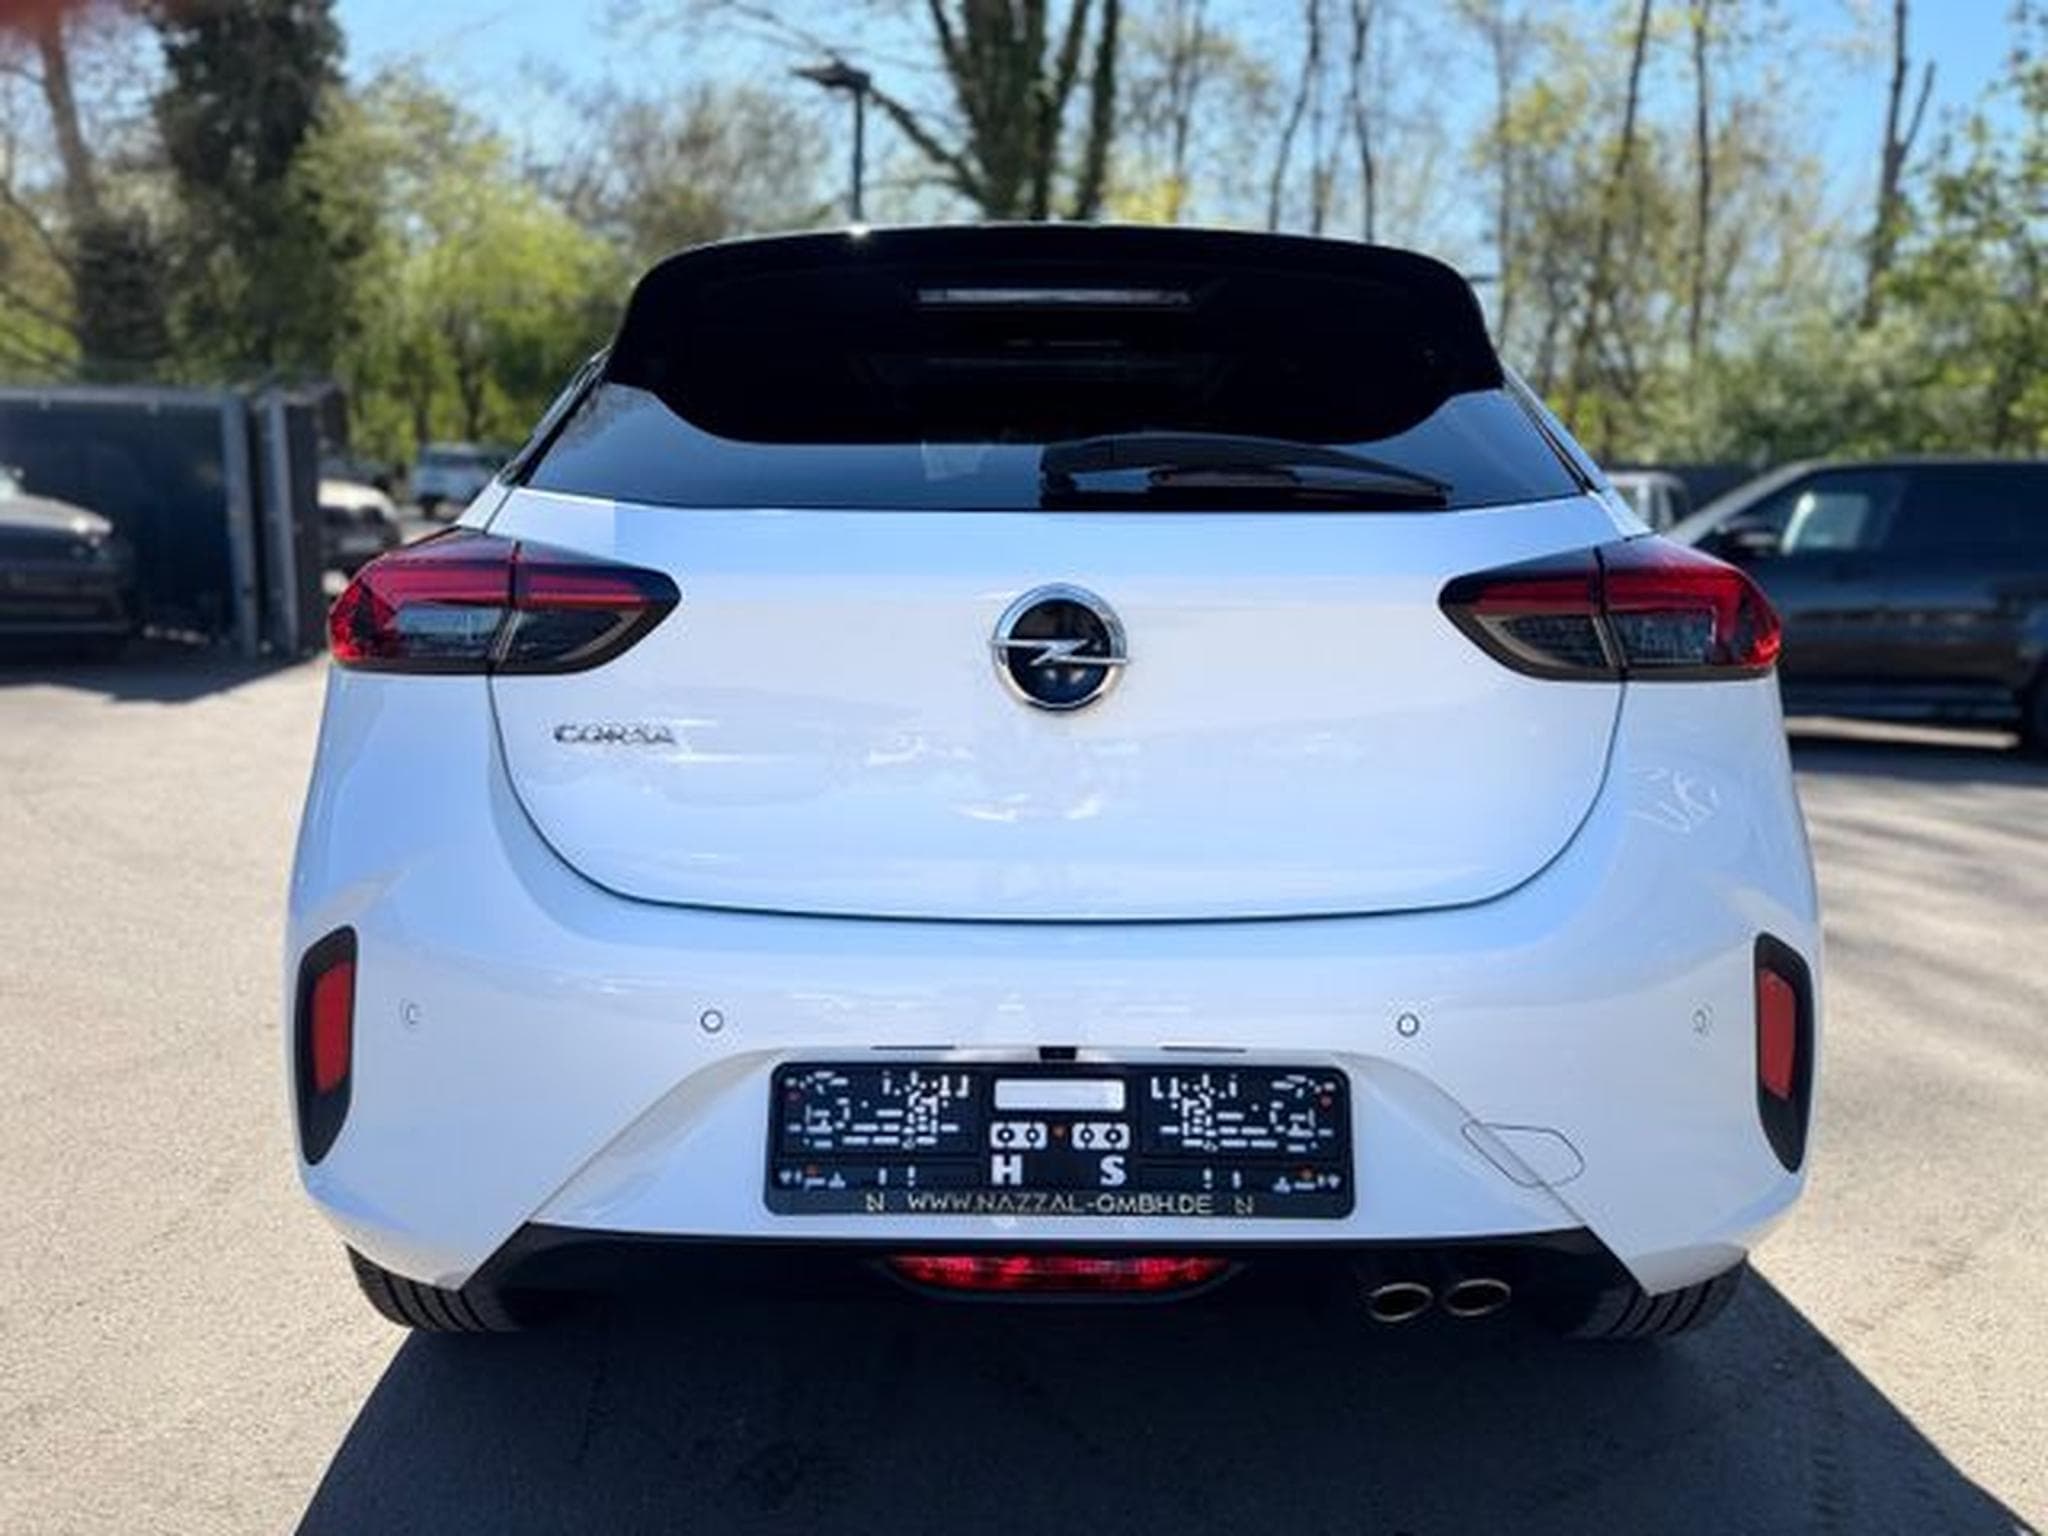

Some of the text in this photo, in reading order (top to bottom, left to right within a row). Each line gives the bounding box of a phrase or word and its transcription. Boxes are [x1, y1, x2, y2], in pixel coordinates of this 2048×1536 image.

[553, 722, 676, 745] CORSA
[991, 1154, 1127, 1186] H S
